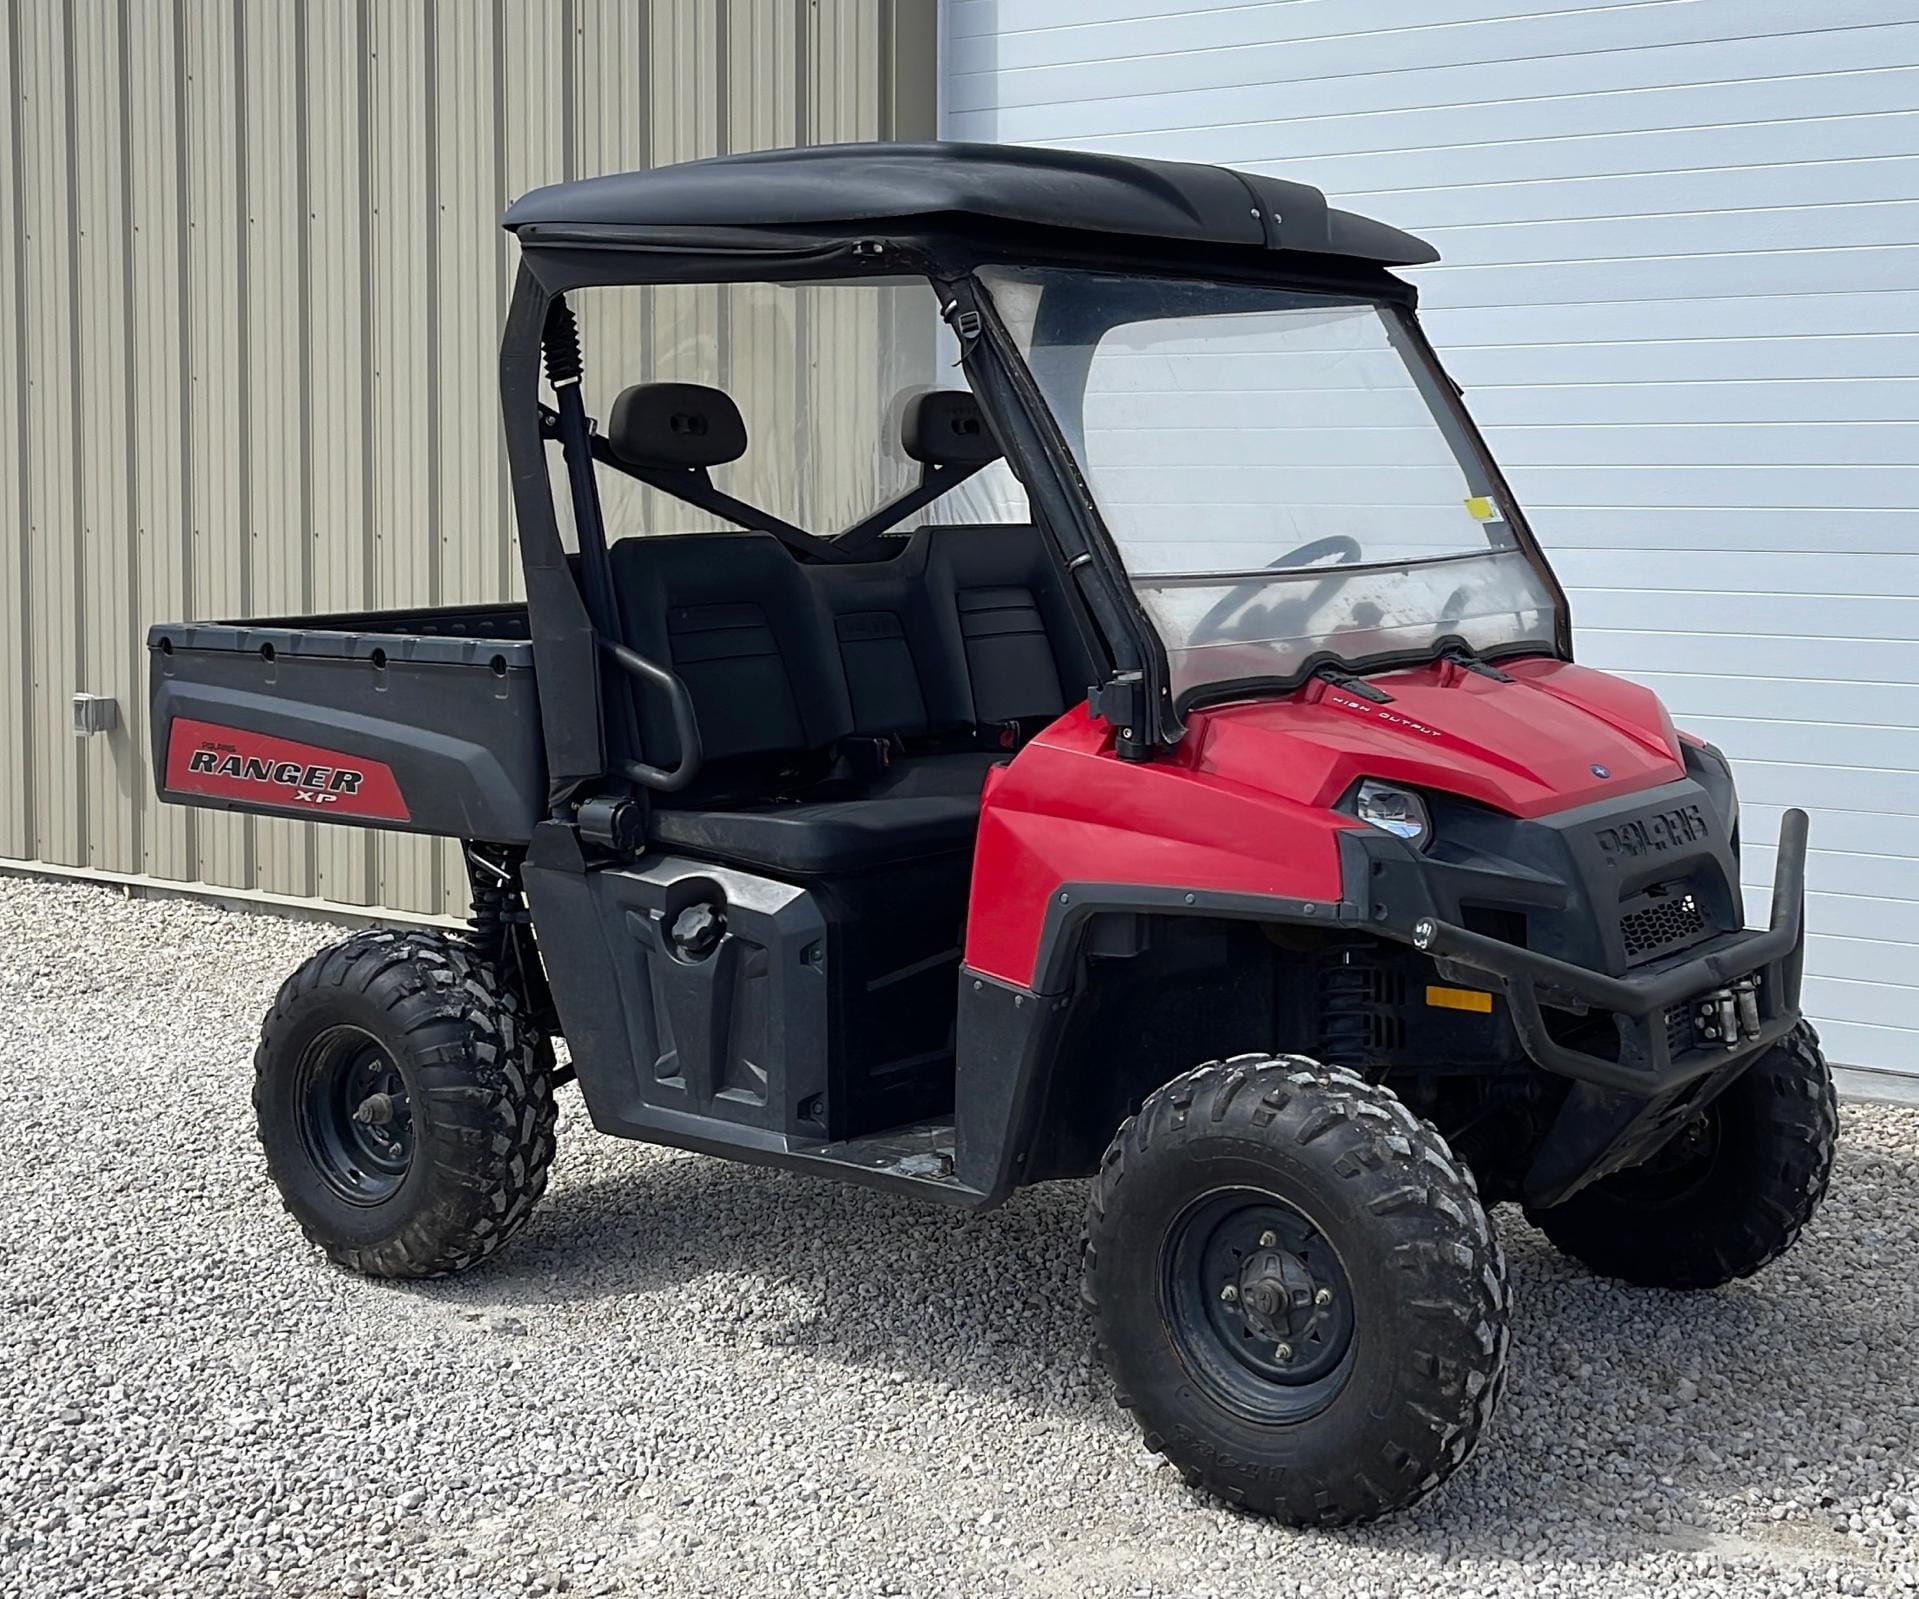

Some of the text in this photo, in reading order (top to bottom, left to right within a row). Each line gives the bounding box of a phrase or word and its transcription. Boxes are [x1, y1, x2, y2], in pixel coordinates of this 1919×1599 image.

[1332, 696, 1441, 737] HIGH OUTPUT
[188, 749, 364, 794] RANGER
[294, 790, 338, 804] XP
[1595, 805, 1708, 867] POLARIS
